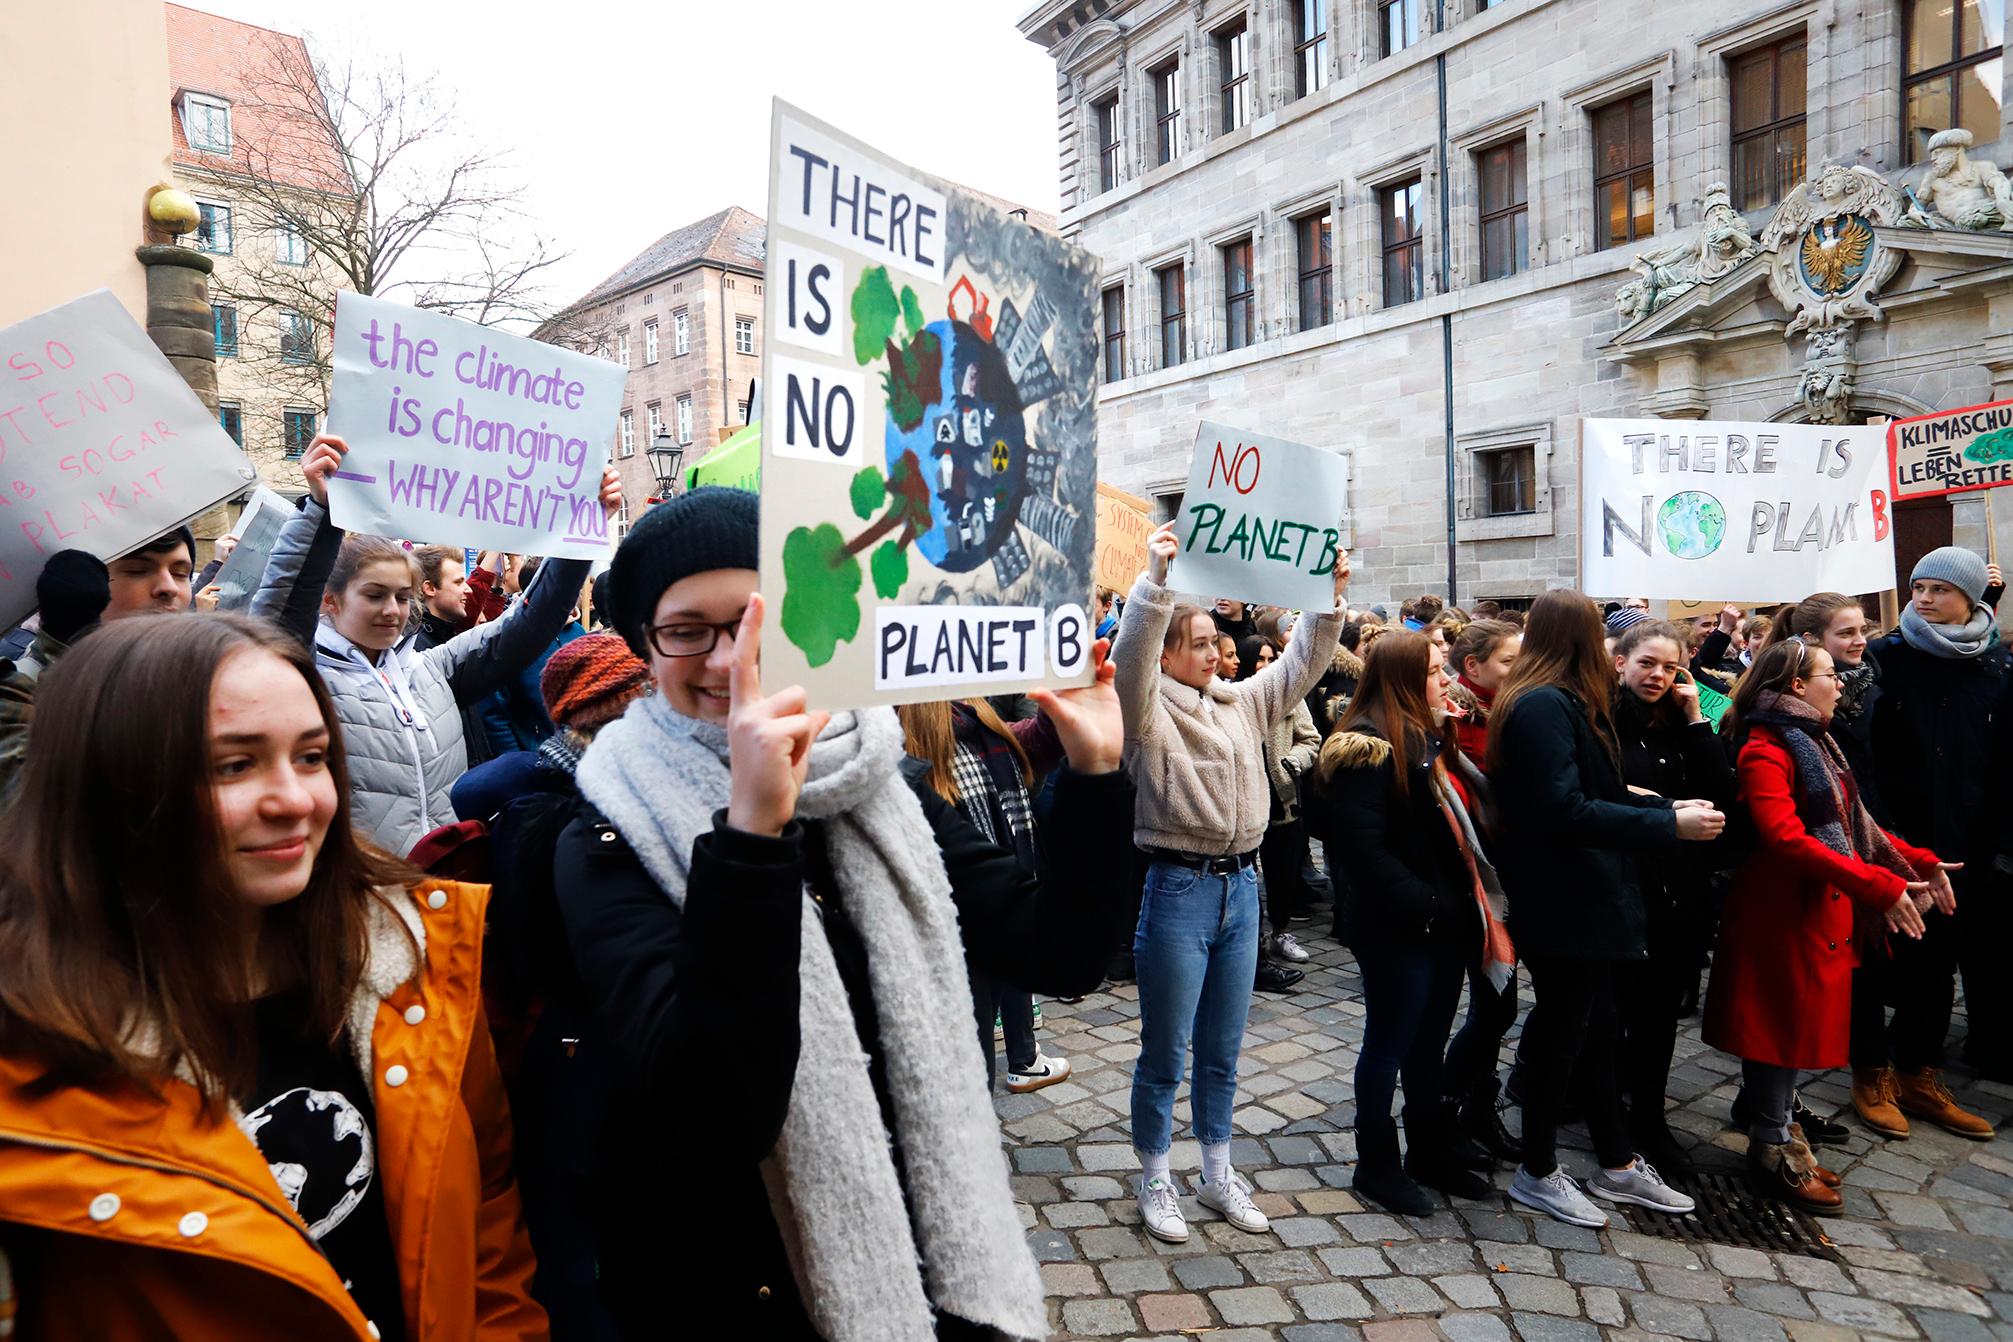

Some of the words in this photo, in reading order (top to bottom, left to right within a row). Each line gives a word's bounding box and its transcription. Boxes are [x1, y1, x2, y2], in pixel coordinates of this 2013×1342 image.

[790, 143, 937, 268] THERE
[787, 257, 832, 338] IS
[8, 340, 75, 381] SO
[361, 318, 438, 378] the
[455, 345, 584, 410] climate
[0, 372, 135, 464] TEND
[388, 386, 422, 437] is
[431, 398, 588, 490] changing
[786, 374, 856, 457] NO
[1901, 408, 2012, 450] KLIMASCHU
[59, 420, 178, 480] SOGAR
[1208, 441, 1261, 495] NO
[1623, 432, 1779, 474] THERE
[1816, 438, 1853, 479] IS
[1899, 453, 1962, 486] LEBEN
[1936, 463, 2012, 490] RETTE
[20, 465, 166, 555] PLAKAT
[389, 459, 460, 513] WHY
[458, 474, 565, 532] AREN'T
[567, 492, 607, 538] YOU
[1108, 503, 1144, 541] SYSTEM
[1870, 489, 1890, 543] B
[1185, 503, 1319, 568] PLANET
[1309, 528, 1339, 576] B
[881, 618, 1036, 680] PLANET
[1057, 616, 1083, 669] B
